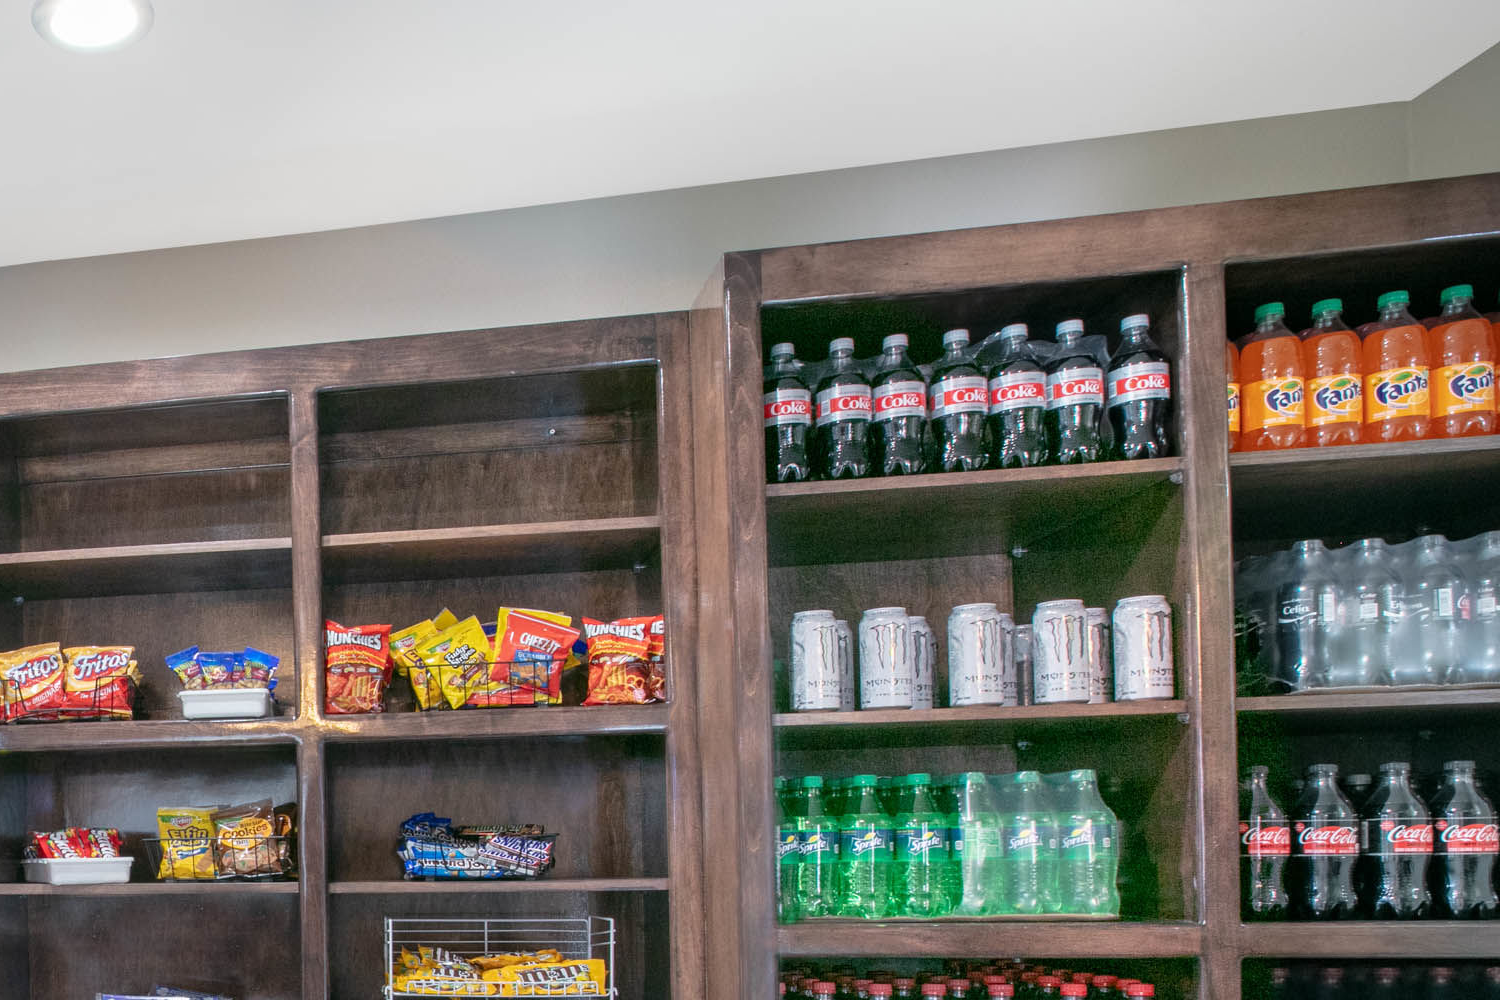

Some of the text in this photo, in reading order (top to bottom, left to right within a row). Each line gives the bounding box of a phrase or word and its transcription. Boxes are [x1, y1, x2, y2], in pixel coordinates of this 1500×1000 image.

[1062, 380, 1100, 396] Coke
[1125, 375, 1166, 392] Coke
[1375, 374, 1428, 405] Fanta
[953, 389, 987, 404] Coke
[997, 384, 1037, 401] Coke
[771, 401, 806, 416] Coke
[882, 393, 920, 409] Coke
[7, 653, 59, 687] Fritos
[73, 651, 128, 680] Fritos
[167, 826, 208, 840] Elfin
[222, 823, 268, 840] Cookies
[852, 838, 882, 852] Sprite
[910, 836, 940, 851] Sprite
[1008, 834, 1039, 850] Sprite
[1062, 833, 1093, 849] Sprite
